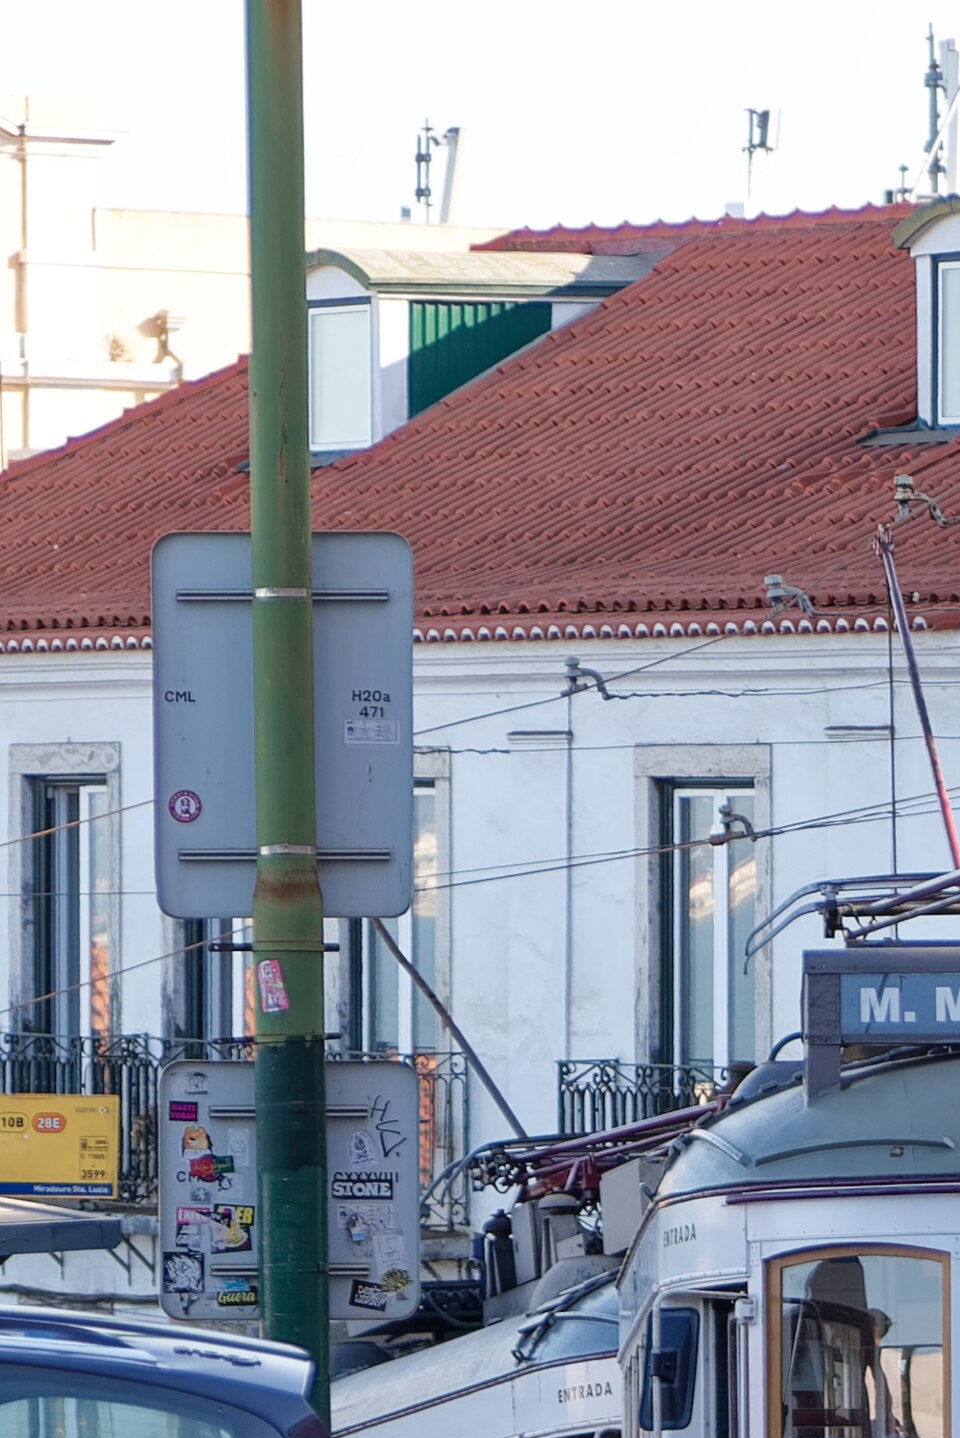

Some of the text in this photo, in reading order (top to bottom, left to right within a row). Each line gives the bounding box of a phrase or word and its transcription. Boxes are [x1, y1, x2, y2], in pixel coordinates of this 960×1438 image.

[164, 691, 196, 702] CML
[359, 706, 384, 717] 471
[860, 987, 915, 1022] M.
[2, 1117, 60, 1128] 10B 28E
[81, 1170, 106, 1178] 3599
[33, 1185, 108, 1193] Miradouro Sta. Luzia
[332, 1182, 391, 1197] STONE
[663, 1223, 697, 1247] ENTRADA
[558, 1381, 612, 1403] ENTRADA
